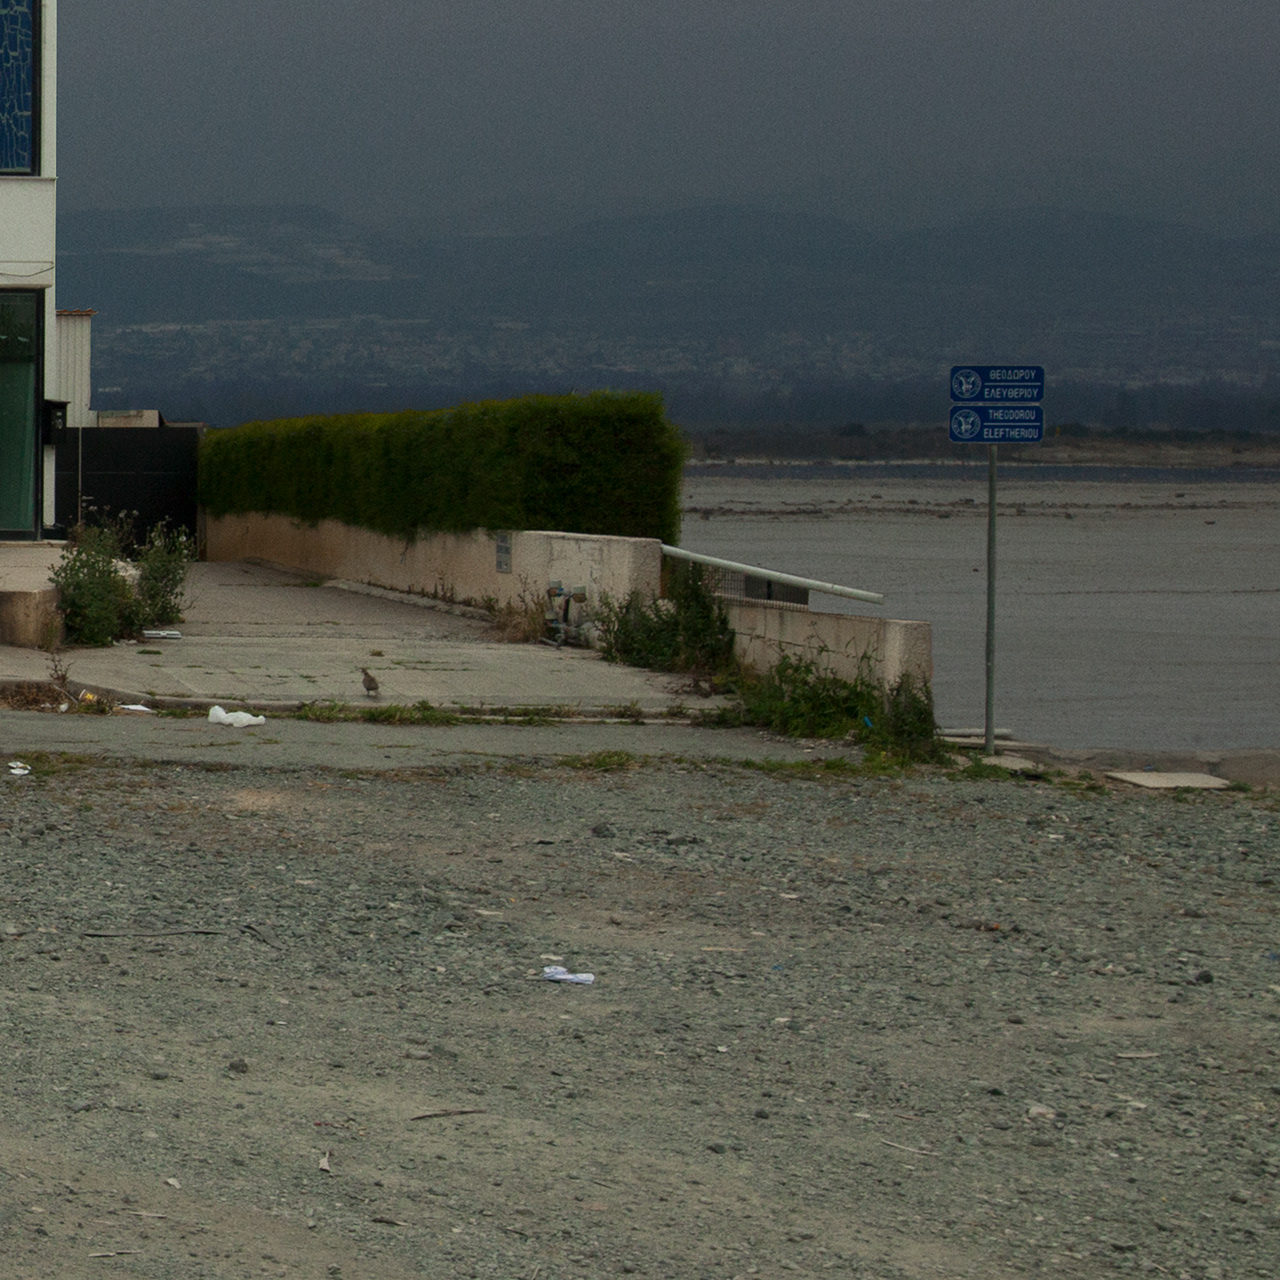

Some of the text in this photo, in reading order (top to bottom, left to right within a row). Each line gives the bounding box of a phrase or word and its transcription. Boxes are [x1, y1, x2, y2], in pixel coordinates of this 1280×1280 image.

[989, 369, 1036, 380] ΘΕΟΔΩΡΟΥ
[984, 388, 1039, 398] ΕΛΕΥΘΕΡΙΟΥ
[988, 409, 1036, 420] THEODOROU
[983, 428, 1039, 439] ELEFTHERIOU
